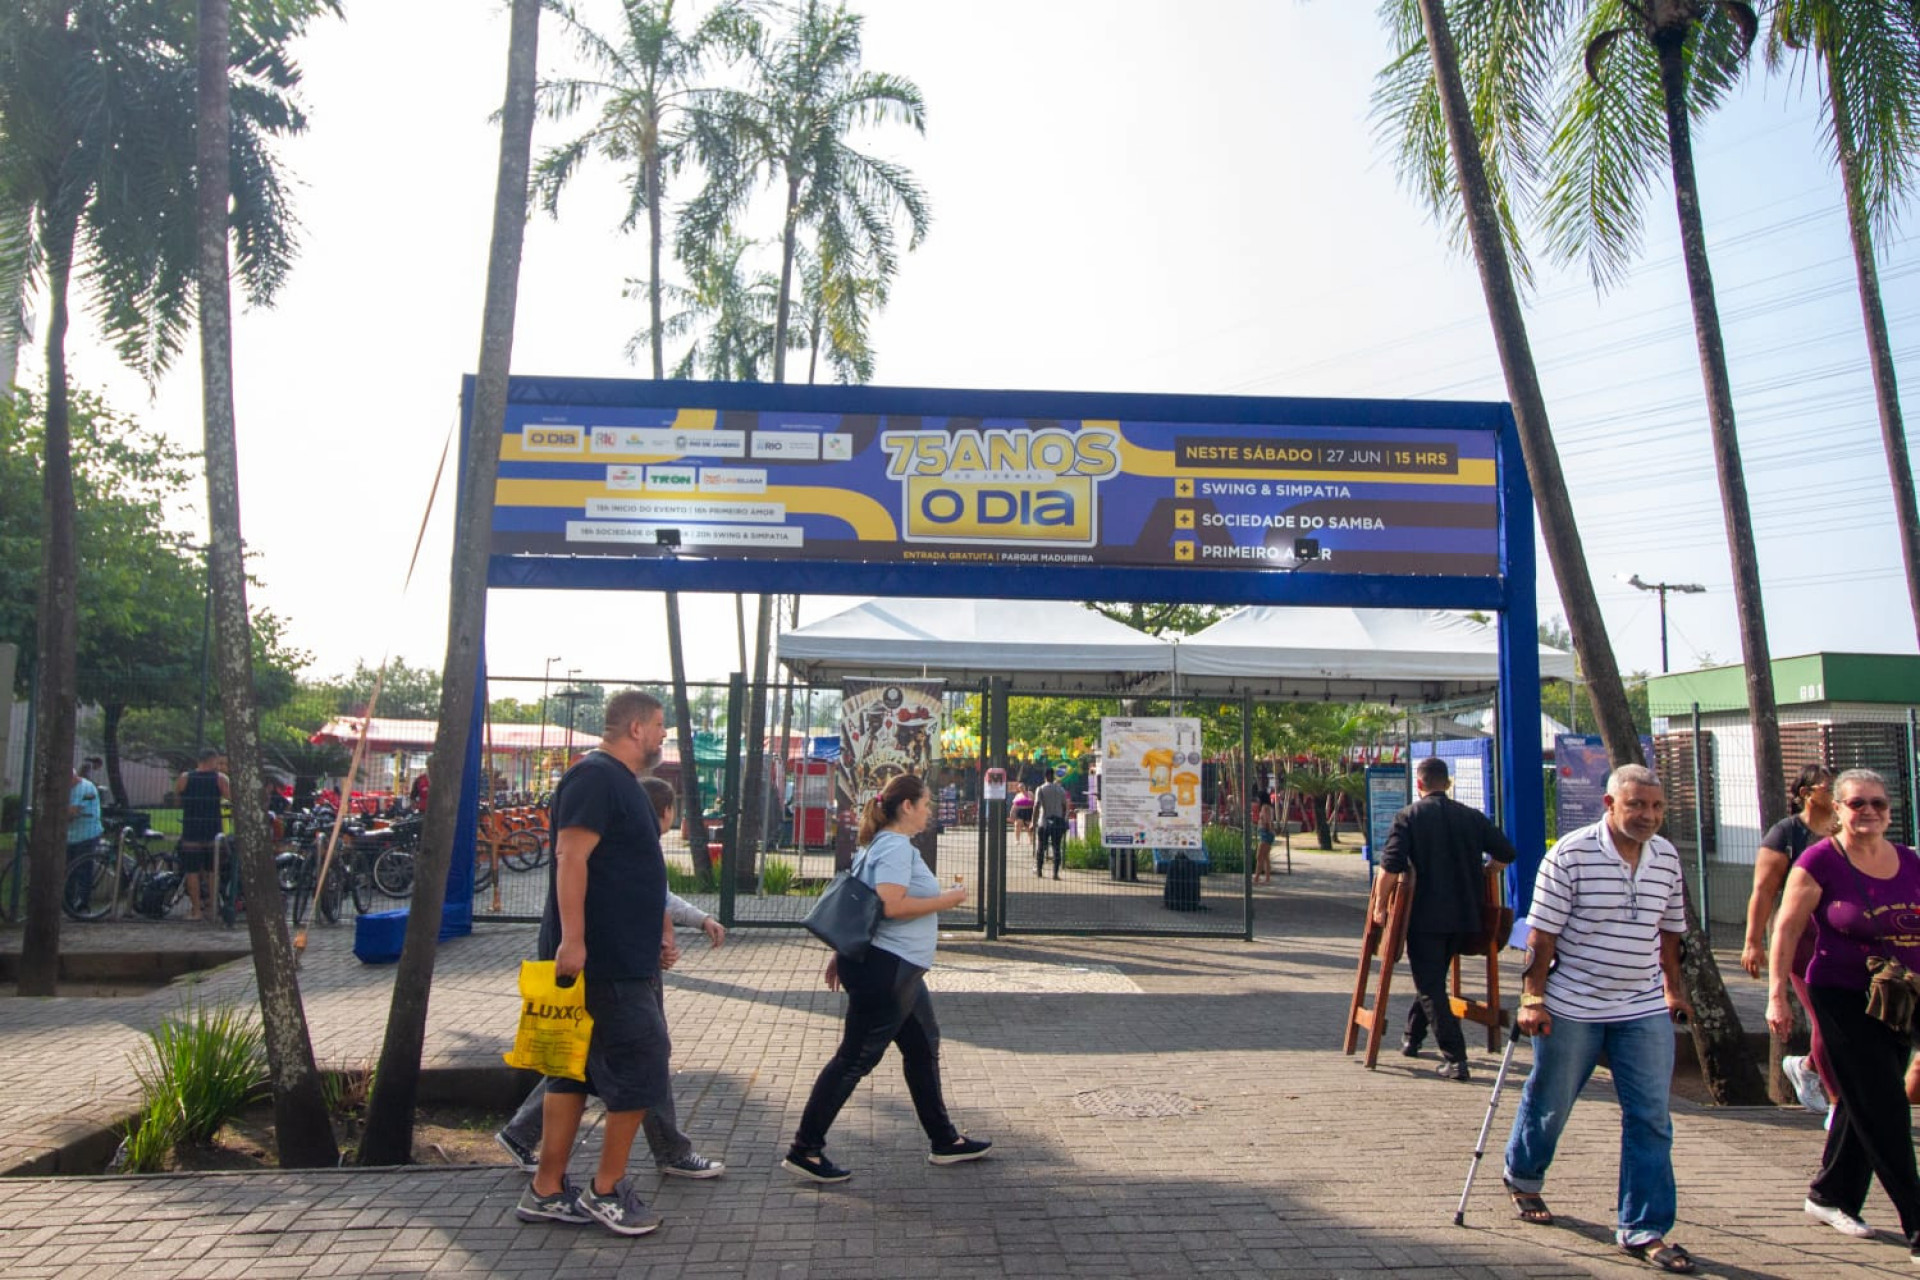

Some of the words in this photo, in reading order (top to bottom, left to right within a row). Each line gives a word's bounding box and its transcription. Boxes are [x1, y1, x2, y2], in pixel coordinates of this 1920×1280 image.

[531, 432, 544, 444] O
[765, 442, 782, 451] RIO
[886, 435, 948, 475] 75
[950, 432, 1117, 475] ANOS
[1186, 446, 1239, 459] NESTE
[1243, 444, 1313, 461] SÁBADO
[1326, 450, 1345, 462] 27
[1349, 450, 1381, 464] JUN
[1394, 452, 1411, 464] 15
[1415, 452, 1448, 465] HRS
[651, 475, 691, 485] TRON
[1202, 483, 1257, 495] SWING
[1261, 484, 1271, 496] &
[1276, 485, 1351, 498] SIMPATIA
[709, 507, 748, 515] PRIMEIRO
[921, 489, 964, 523] O
[1202, 514, 1295, 528] SOCIEDADE
[1300, 516, 1324, 528] DO
[1329, 517, 1385, 530] SAMBA
[903, 551, 946, 559] ENTRADA
[949, 552, 994, 560] GRATUITA
[1001, 553, 1038, 561] PARQUE
[1041, 554, 1094, 562] MADUREIRA
[1202, 545, 1279, 559] PRIMEIRO
